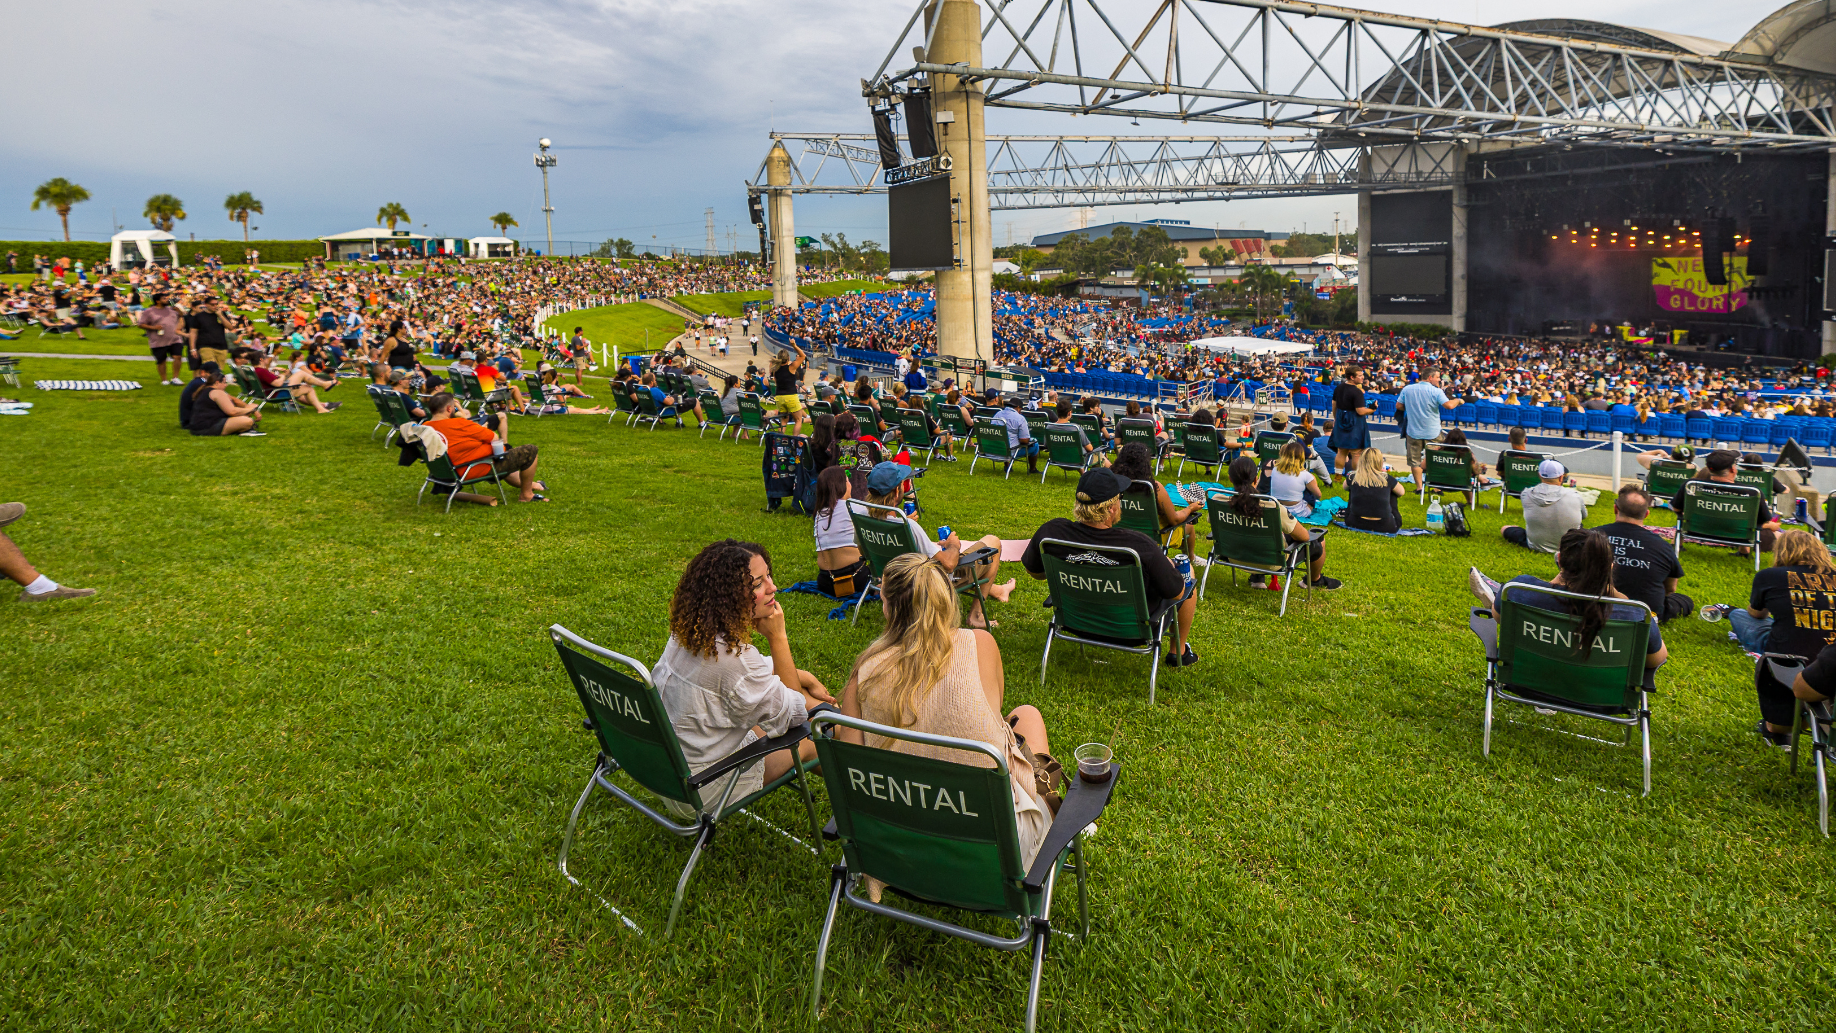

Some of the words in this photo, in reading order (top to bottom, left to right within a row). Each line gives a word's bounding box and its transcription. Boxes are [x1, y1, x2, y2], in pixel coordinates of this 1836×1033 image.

[1677, 258, 1702, 273] NE
[1669, 277, 1739, 294] FOUND
[1669, 294, 1740, 312] GLORY
[741, 401, 757, 409] RENTAL
[901, 419, 922, 427] RENTAL
[979, 427, 1003, 436] RENTAL
[1125, 429, 1149, 437] RENTAL
[1050, 434, 1076, 443] RENTAL
[1187, 434, 1211, 443] RENTAL
[1263, 442, 1282, 451] RENT
[1432, 455, 1464, 465] RENTAL
[1512, 463, 1539, 472] RENTA
[1656, 470, 1689, 480] RENTAL
[1735, 473, 1765, 483] ENTAL
[1697, 499, 1747, 513] RENTAL
[1217, 511, 1269, 529] RENTAL
[860, 527, 904, 547] RENTAL
[1614, 546, 1626, 556] IS
[1059, 571, 1128, 594] RENTAL
[1789, 589, 1817, 609] OF
[579, 674, 651, 725] RENTAL
[848, 767, 979, 818] RENTAL
